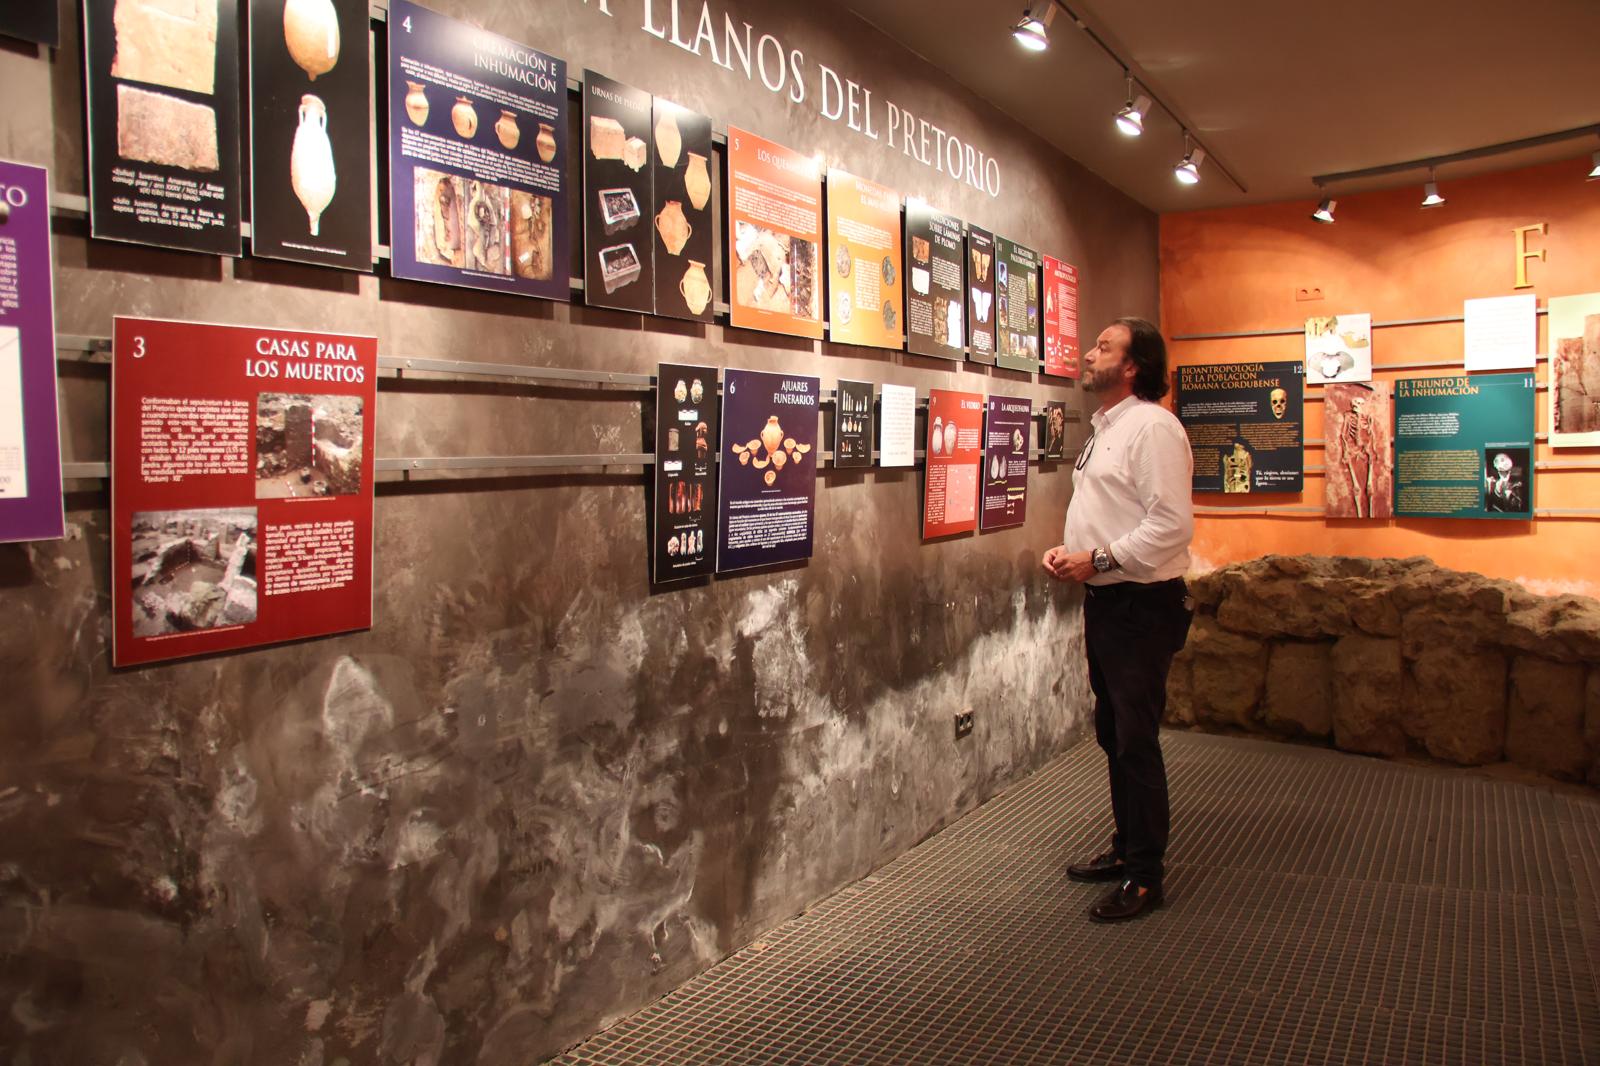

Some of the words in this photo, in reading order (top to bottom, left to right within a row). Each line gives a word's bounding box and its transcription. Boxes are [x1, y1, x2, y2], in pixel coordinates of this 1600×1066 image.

[402, 15, 411, 33] 4
[474, 53, 556, 93] INHUMACIÓN
[551, 63, 557, 77] E
[592, 85, 613, 100] URNAS
[641, 0, 804, 103] LLANOS
[819, 64, 878, 140] DEL
[886, 100, 1000, 197] PRETORIO
[734, 138, 740, 150] 5
[757, 148, 771, 164] LOS
[1512, 222, 1548, 289] F
[132, 336, 146, 358] 3
[256, 337, 310, 358] CASAS
[316, 342, 357, 361] PARA
[246, 358, 279, 378] LOS
[284, 361, 365, 384] MUERTOS
[1294, 365, 1302, 374] 12
[1182, 374, 1192, 383] DE
[1196, 374, 1206, 382] LA
[1182, 382, 1220, 391] ROMANA
[1221, 379, 1280, 390] CORDUBENSE
[1400, 381, 1409, 389] EL
[1412, 379, 1454, 388] TRIUNFO
[1456, 378, 1469, 387] DE
[1524, 378, 1533, 388] 11
[730, 381, 736, 394] 6
[781, 380, 808, 392] AJUARES
[774, 393, 814, 406] FUNERARIOS
